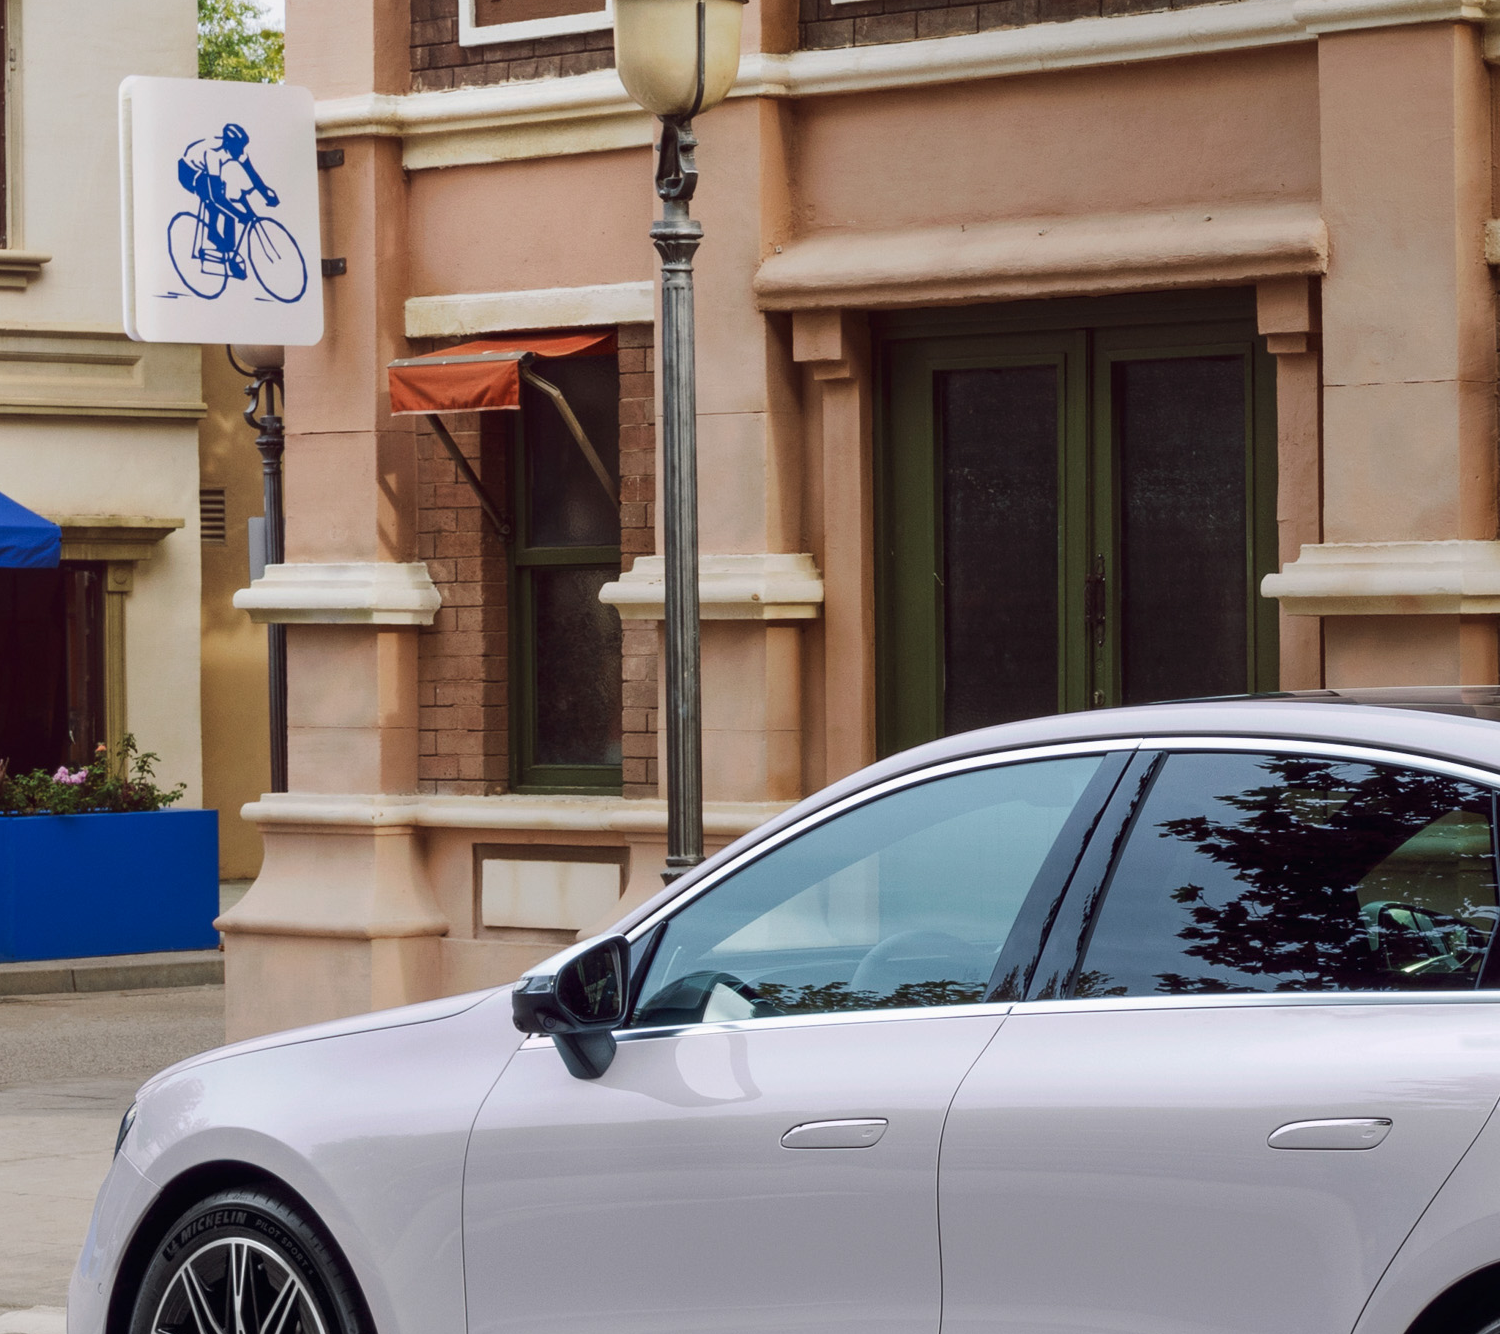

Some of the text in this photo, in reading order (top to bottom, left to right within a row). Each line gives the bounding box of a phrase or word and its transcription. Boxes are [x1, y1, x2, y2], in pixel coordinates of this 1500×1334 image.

[180, 1211, 309, 1268] MICHELIN PILOT SPORT
